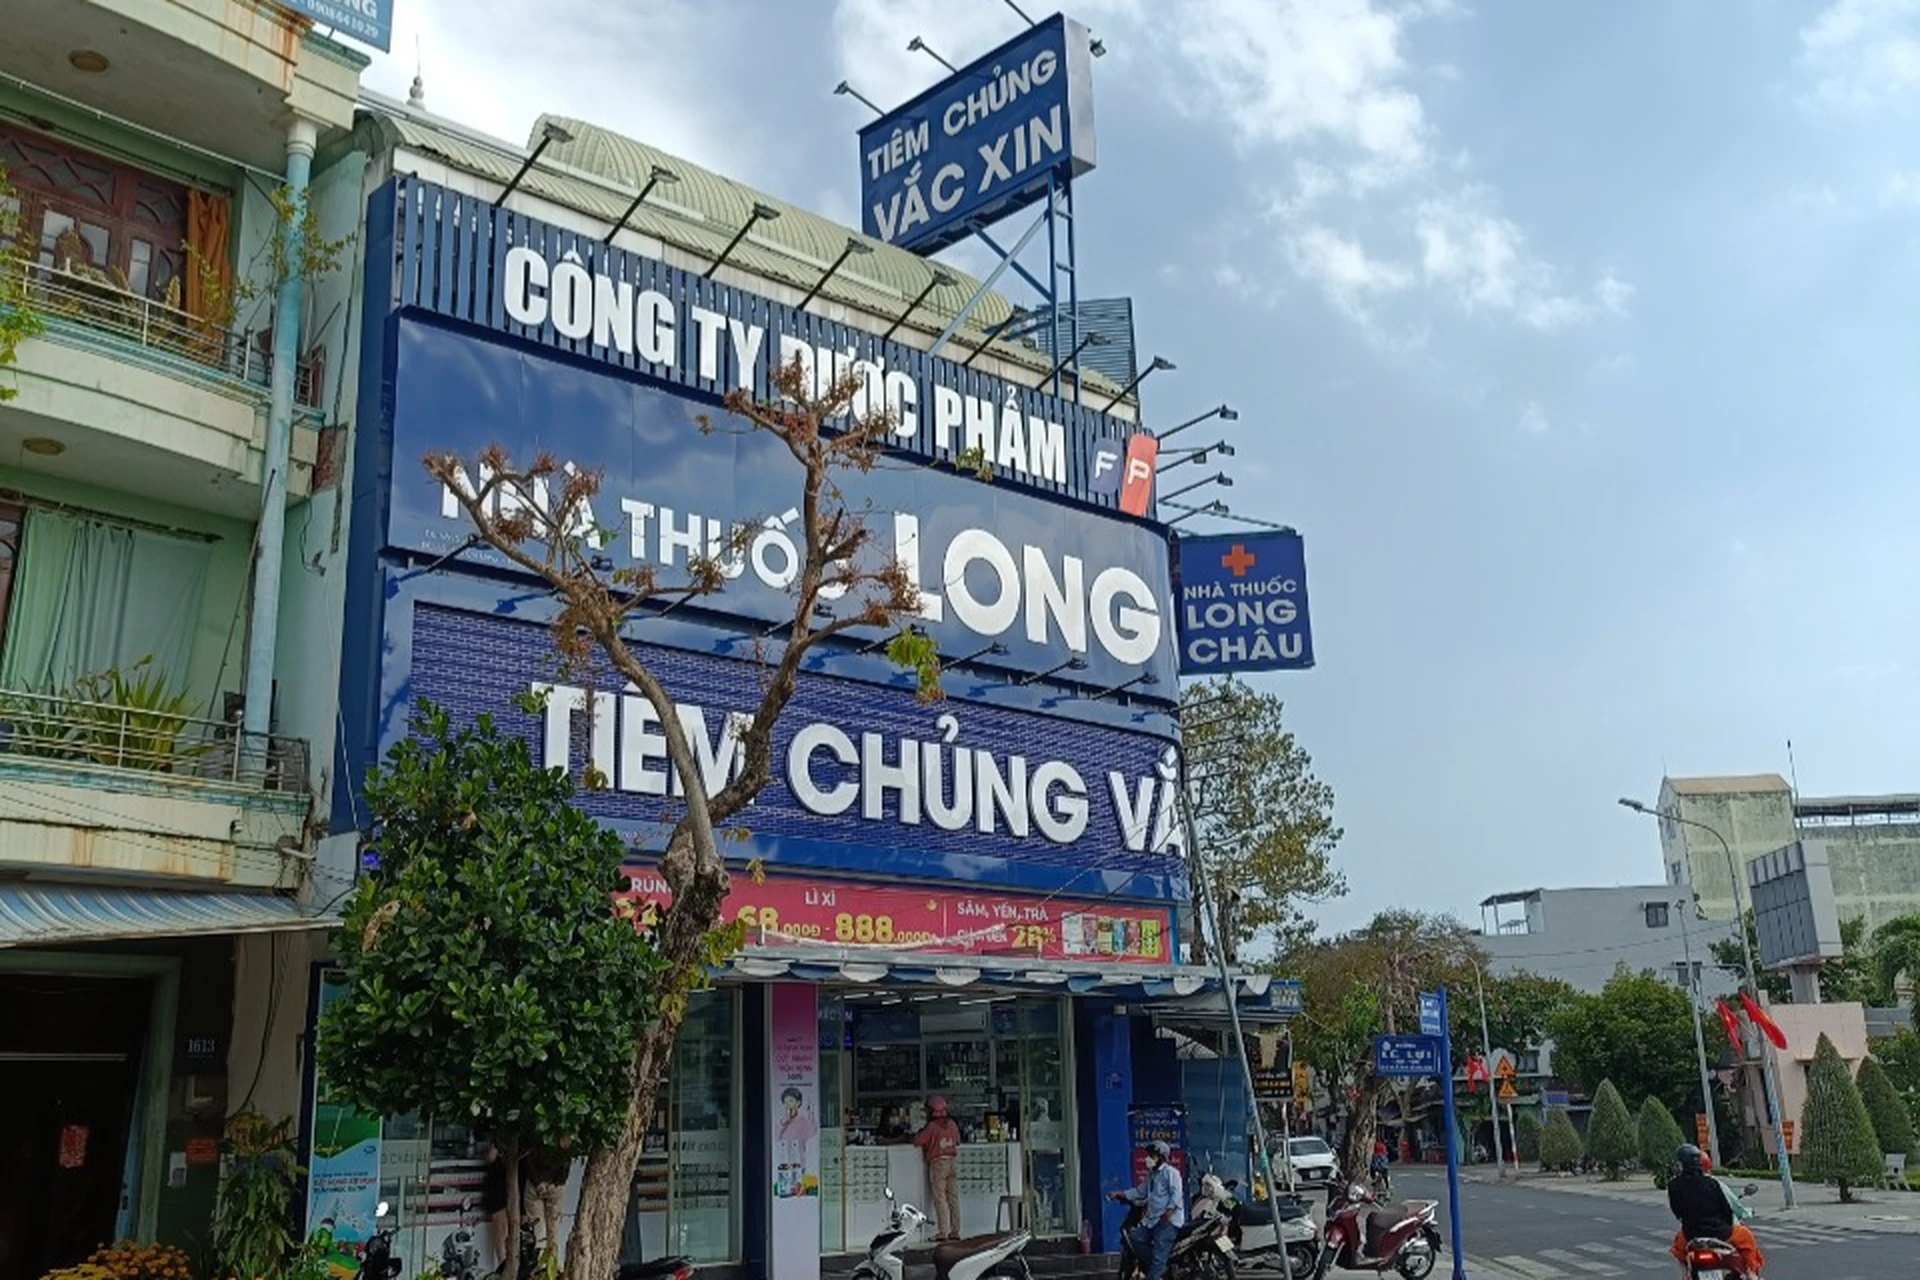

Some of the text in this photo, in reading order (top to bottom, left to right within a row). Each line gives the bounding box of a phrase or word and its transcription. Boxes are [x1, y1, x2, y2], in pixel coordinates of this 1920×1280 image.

[868, 49, 1058, 180] TIÊM CHỦNG
[873, 104, 1064, 244] VẮC XIN
[504, 246, 676, 368] CÔNG
[691, 306, 764, 392] TY
[934, 386, 1067, 484] PHẨM
[441, 460, 605, 551] NHÀ
[893, 511, 1161, 664] LONG
[1183, 574, 1297, 600] NHÀ THUỐC
[1187, 598, 1298, 630] LONG
[1187, 626, 1303, 664] CHÂU
[531, 681, 756, 805] TIÊM
[786, 714, 1089, 844] CHỦNG
[630, 874, 673, 894] RÚN
[957, 899, 989, 919] SÂM,
